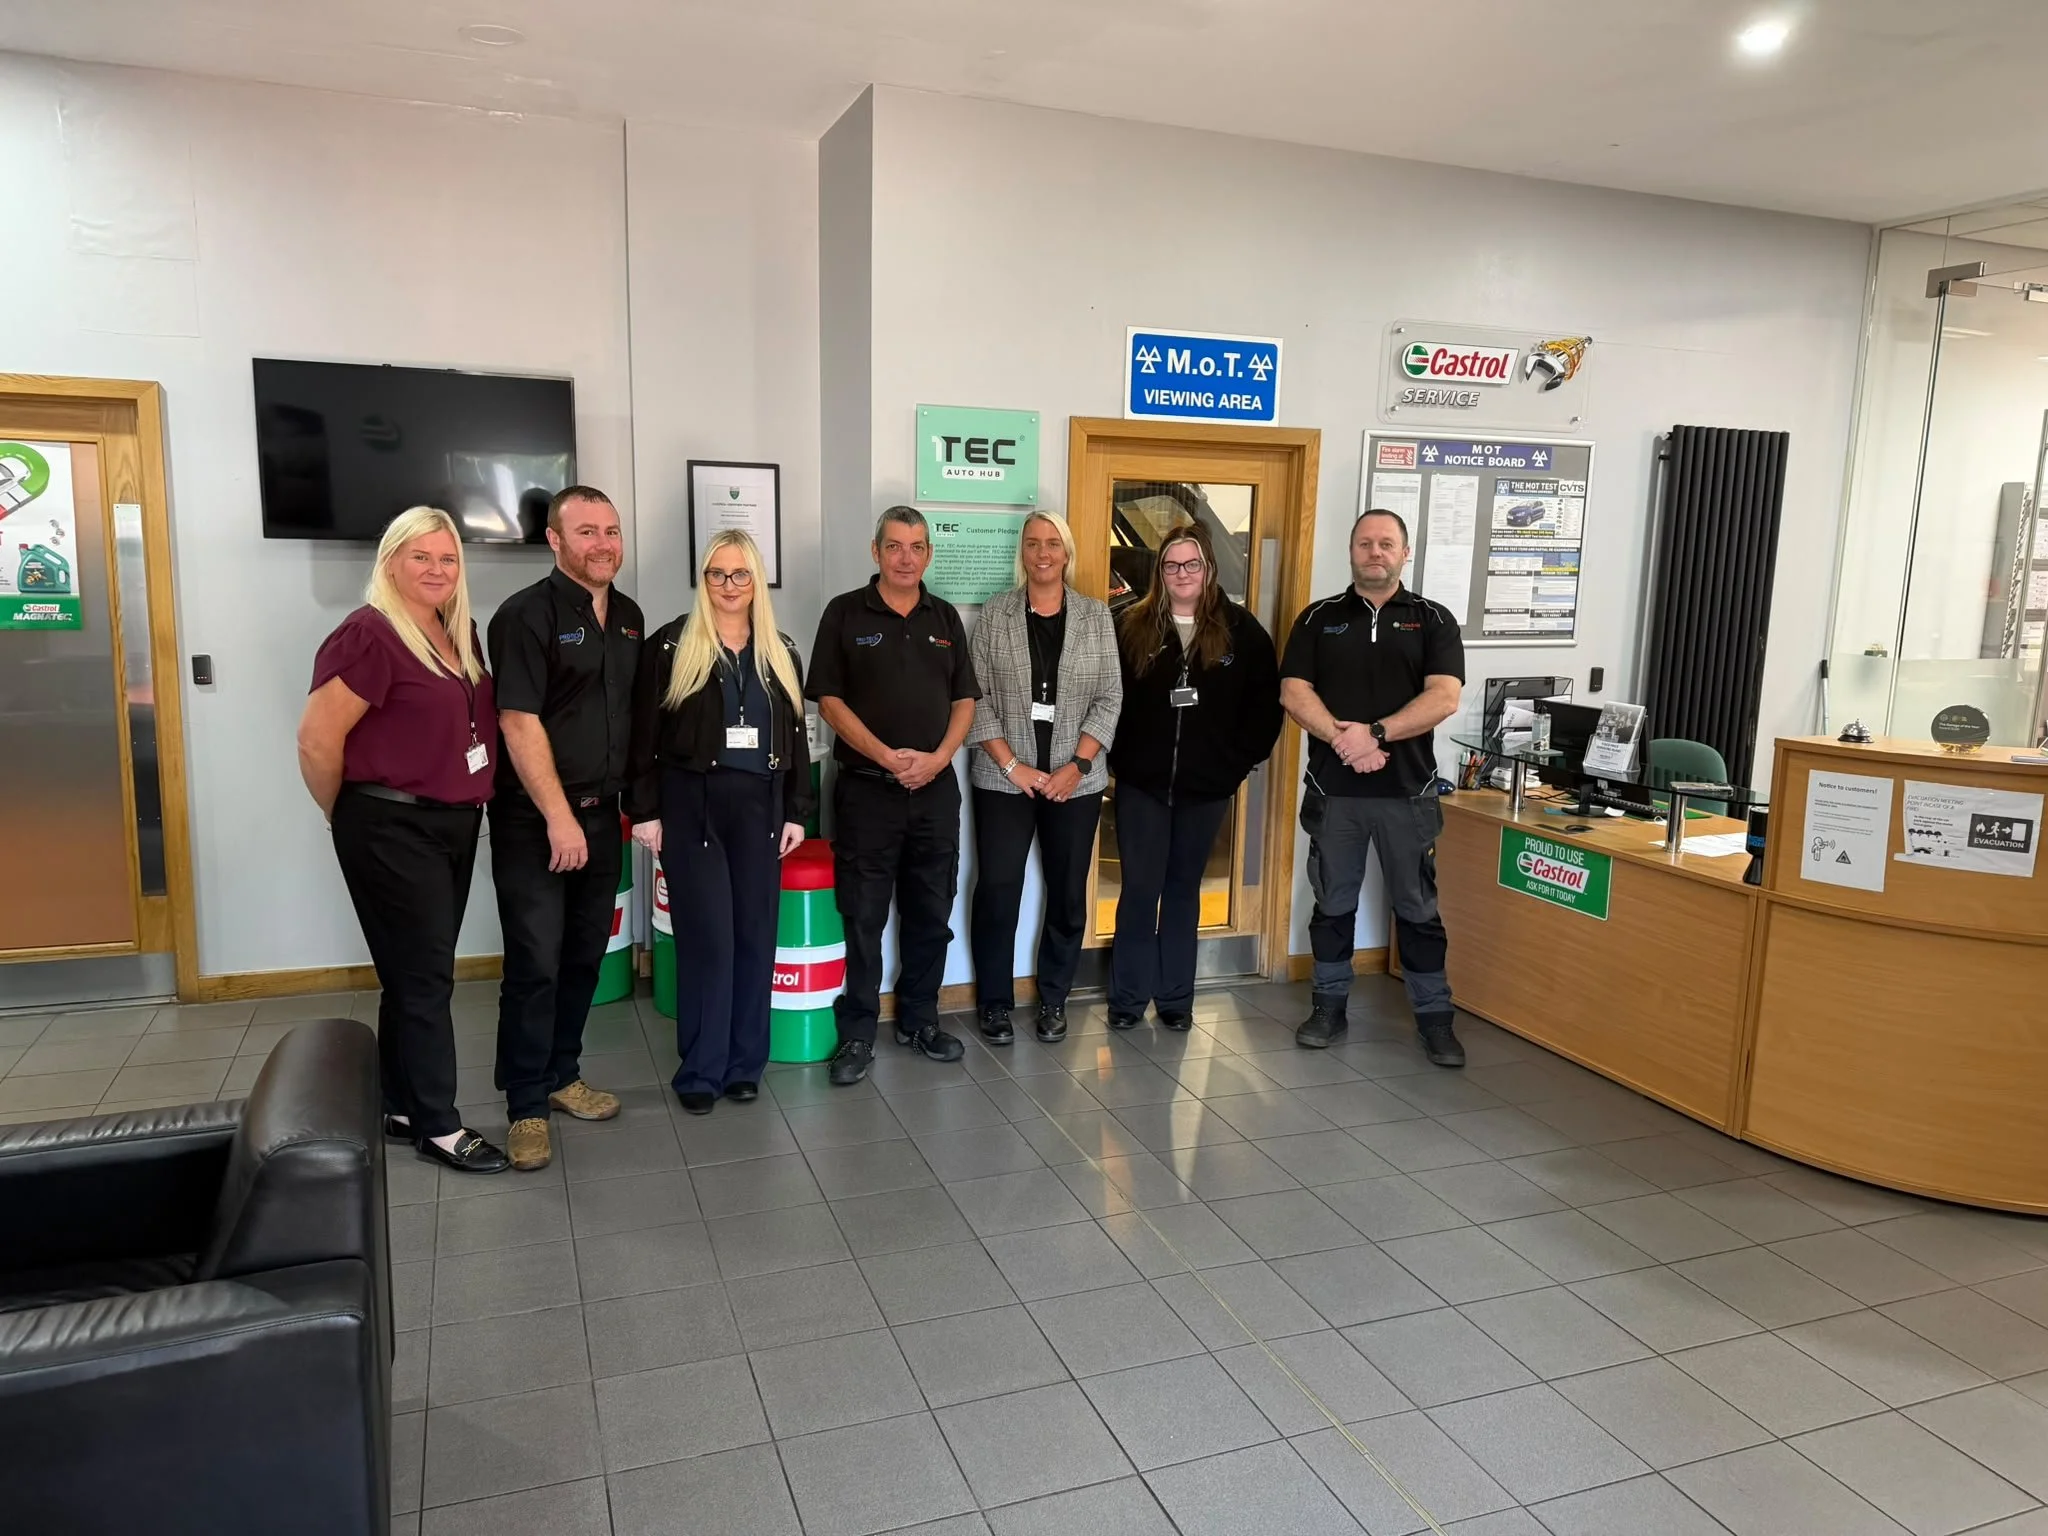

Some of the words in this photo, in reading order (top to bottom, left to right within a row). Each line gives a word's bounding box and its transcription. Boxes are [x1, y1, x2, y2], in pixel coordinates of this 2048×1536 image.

[1167, 348, 1243, 378] M.o.T.
[1429, 347, 1509, 379] Castrol
[1143, 388, 1214, 408] VIEWING
[1218, 393, 1263, 411] AREA
[1401, 387, 1480, 407] SERVICE
[1471, 444, 1502, 456] MOT
[1444, 454, 1484, 466] NOTICE
[1488, 456, 1526, 468] BOARD
[946, 469, 974, 477] AUTO
[980, 470, 1001, 478] HUB
[1510, 481, 1524, 489] THE
[1525, 482, 1540, 490] MOT
[1541, 483, 1558, 491] TEST
[1559, 483, 1585, 493] CVTS
[31, 604, 57, 612] Castrol
[13, 612, 73, 621] MAGNATEC
[1818, 782, 1837, 790] Notice
[1907, 794, 1941, 802] EVACUATION
[1974, 837, 2025, 849] EVACUATION
[1524, 837, 1553, 856] PROUD
[1554, 845, 1566, 860] TO
[1566, 848, 1585, 866] USE
[1533, 858, 1583, 889] Castrol
[1526, 880, 1538, 891] ASK
[1538, 883, 1550, 895] FOR
[1550, 886, 1556, 897] IT
[1556, 887, 1576, 904] TODAY
[772, 969, 799, 986] trol
